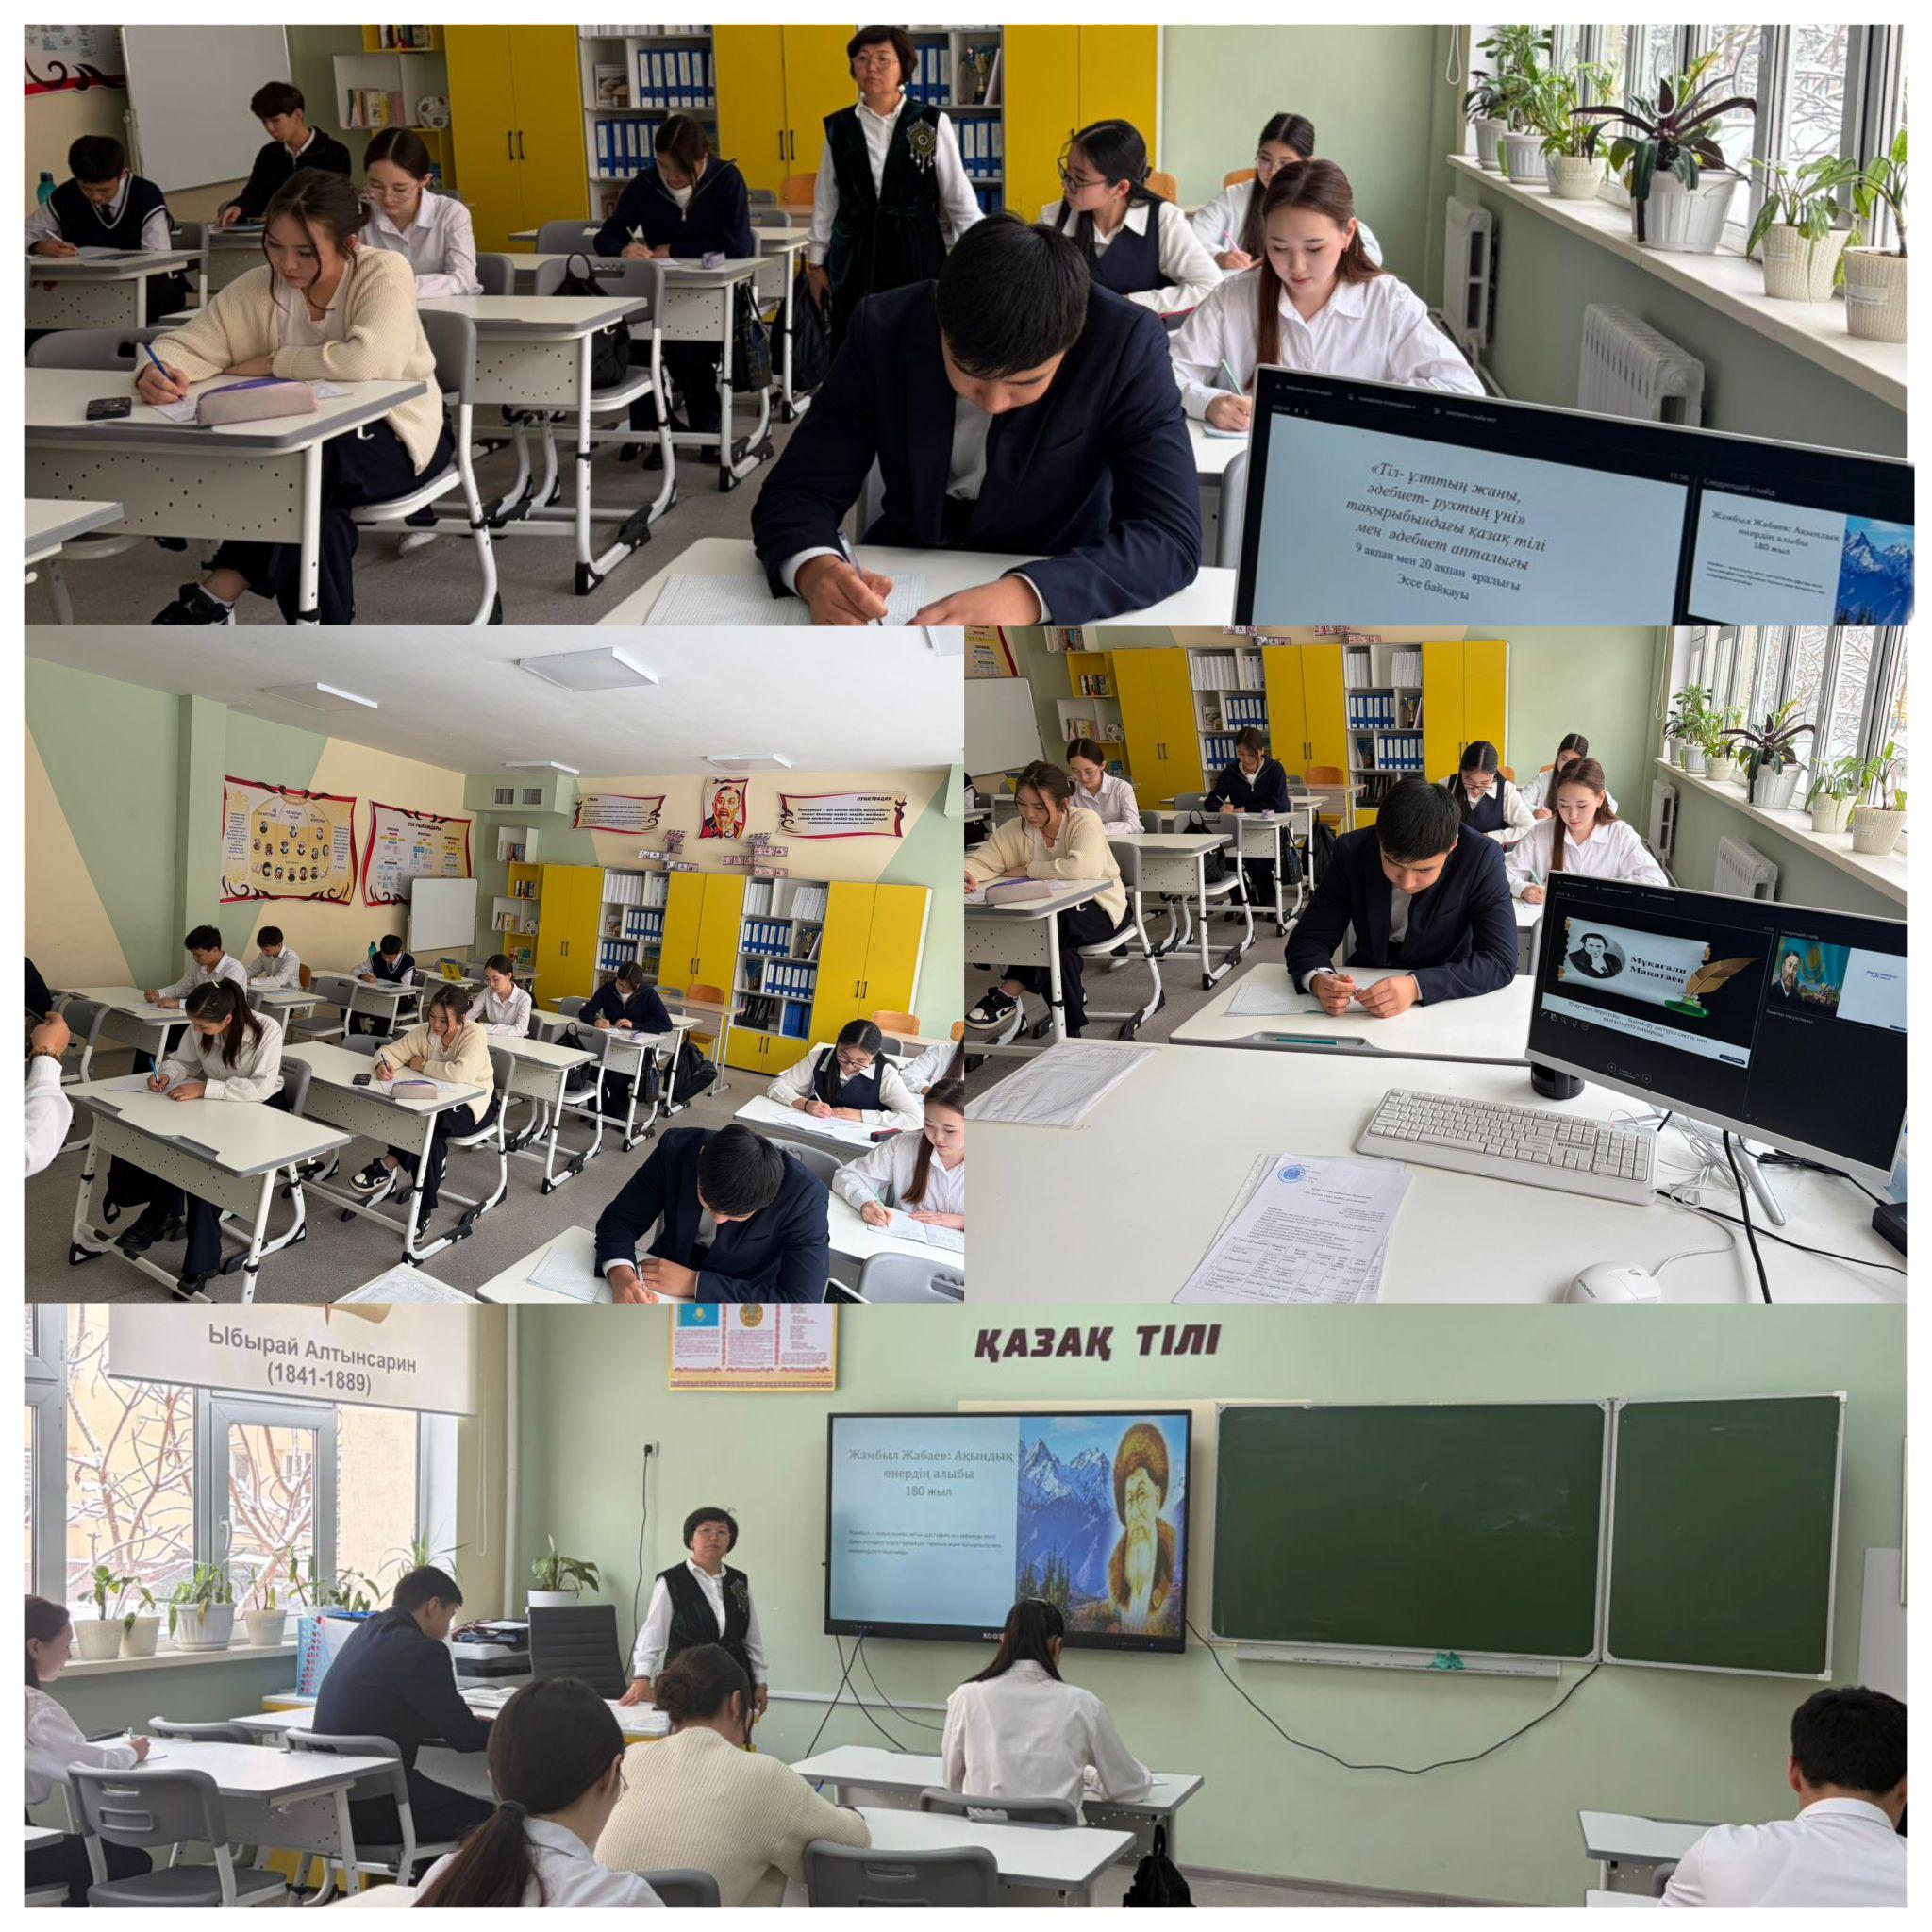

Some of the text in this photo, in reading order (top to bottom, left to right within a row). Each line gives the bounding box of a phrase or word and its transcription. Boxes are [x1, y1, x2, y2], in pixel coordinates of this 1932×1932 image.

[1371, 462, 1522, 504] «Тіл- ұлттың жаны,
[1366, 483, 1526, 525] әдебиет- рухтың үні»
[1346, 500, 1547, 553] тақырыбындағы қазақ тілі
[1355, 523, 1530, 572] мен әдебиет апталығы
[1356, 542, 1363, 553] 9
[1396, 555, 1417, 566] мен
[1419, 557, 1433, 570] 20
[1396, 573, 1423, 589] Эссе
[208, 1324, 418, 1374] Ыбырай Алтынсарин
[974, 1324, 1223, 1363] ҚАЗАҚ ТІЛІ
[267, 1362, 372, 1396] (1841-1889)
[849, 1449, 1014, 1462] Жамбыл Жабаев: Ақындық
[884, 1468, 974, 1481] өнердің алыбы
[906, 1486, 953, 1497] 180 жыл
